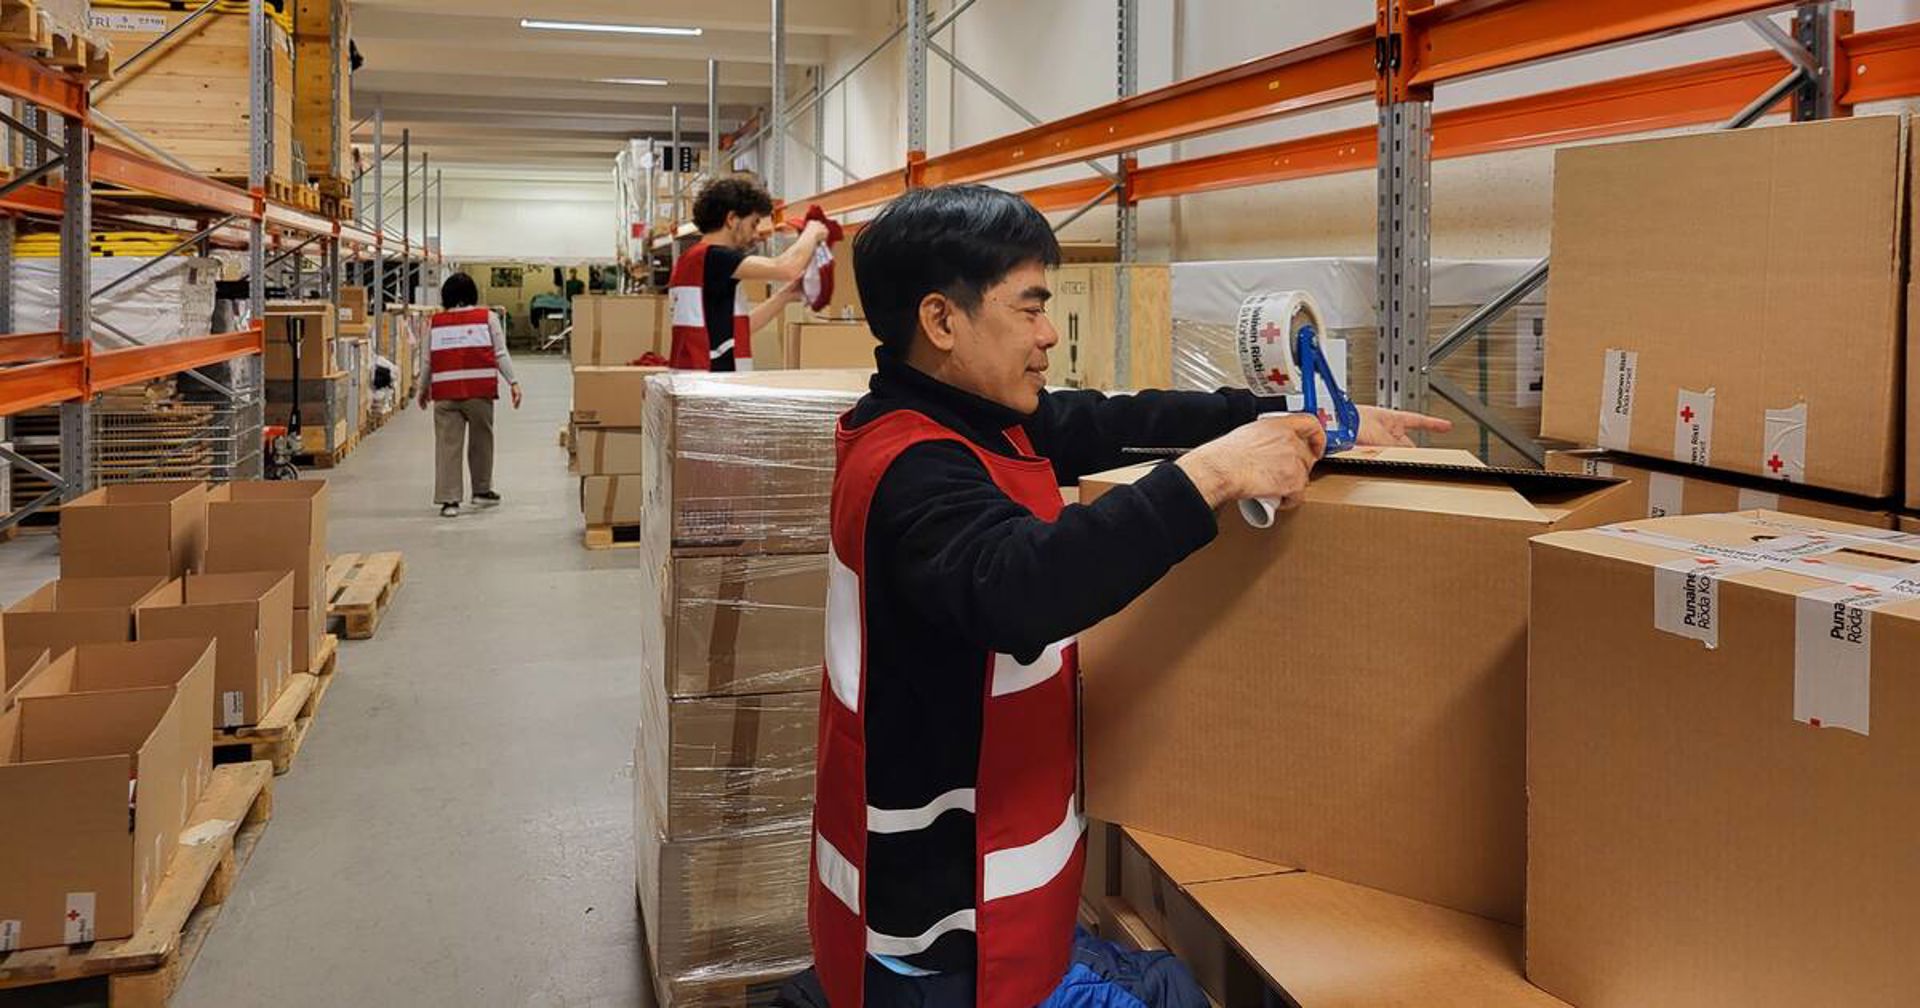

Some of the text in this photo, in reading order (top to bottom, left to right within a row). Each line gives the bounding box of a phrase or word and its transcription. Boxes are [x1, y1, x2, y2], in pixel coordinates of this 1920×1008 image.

[1697, 597, 1711, 630] Röda
[1829, 602, 1845, 640] Puna
[1846, 607, 1863, 644] Röda
